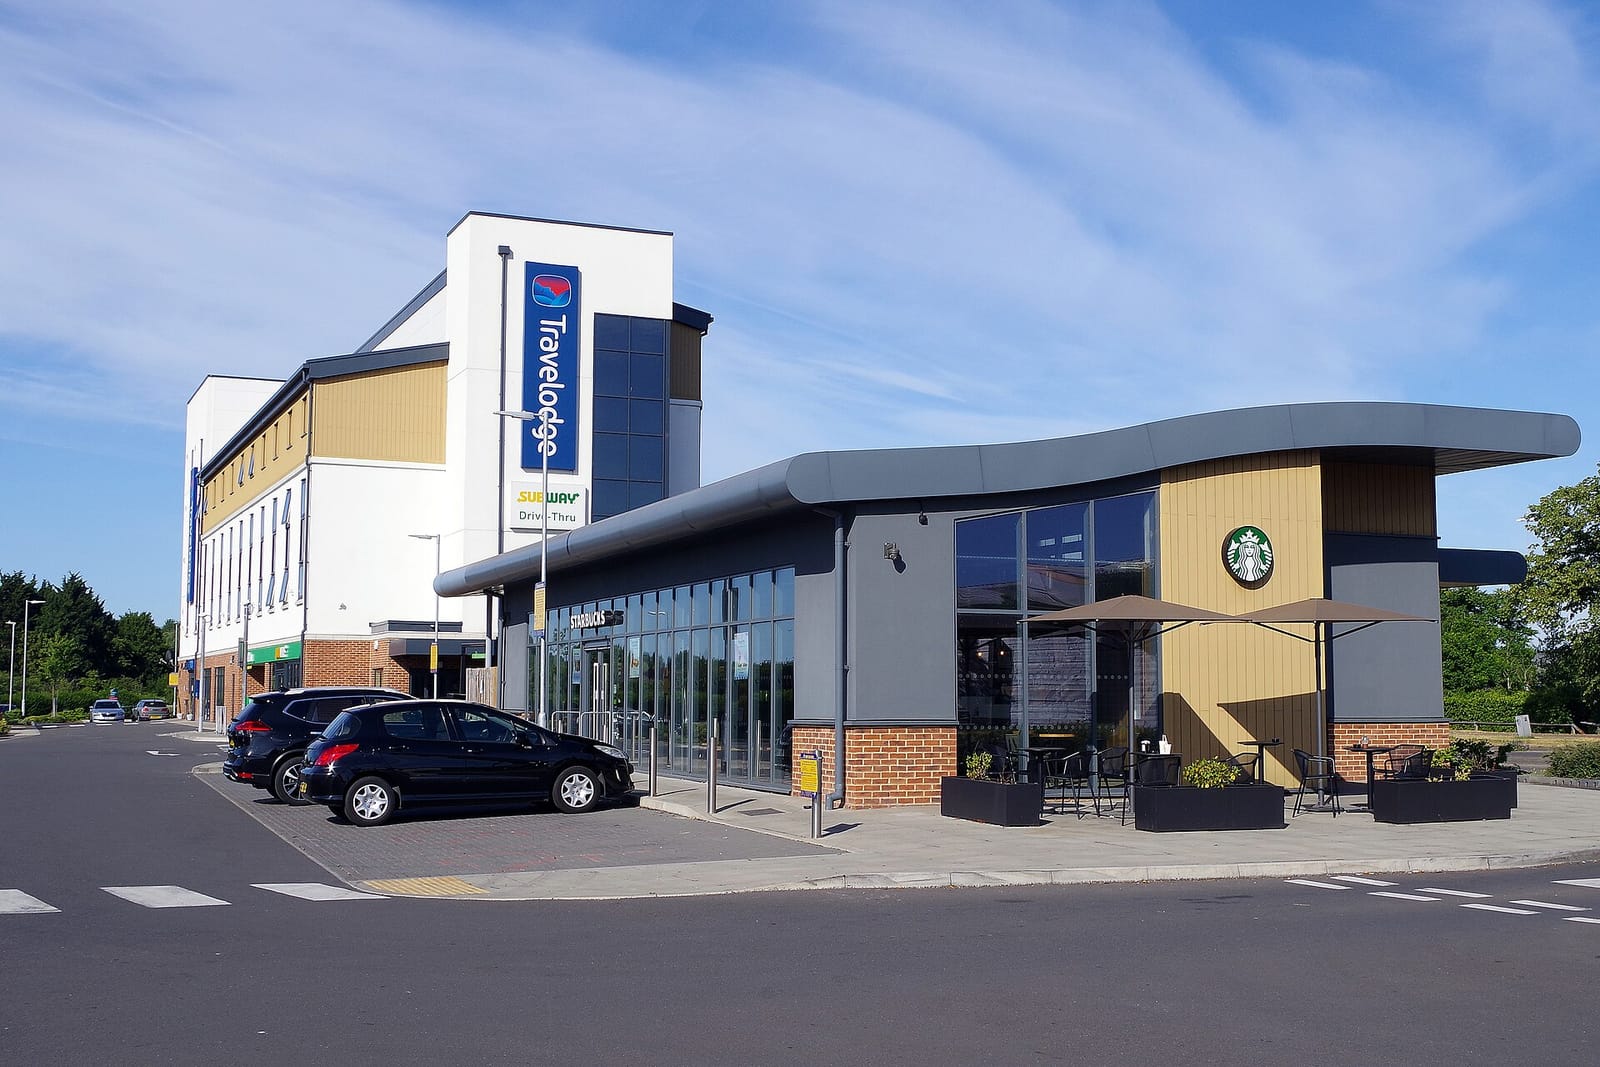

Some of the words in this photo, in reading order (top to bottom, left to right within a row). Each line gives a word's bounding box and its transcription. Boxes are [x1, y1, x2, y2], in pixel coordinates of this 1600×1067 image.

[531, 314, 567, 457] Travelodge
[517, 491, 580, 504] SUBWAY
[519, 511, 576, 522] Driv-Thru
[570, 610, 606, 629] STARBUCKS
